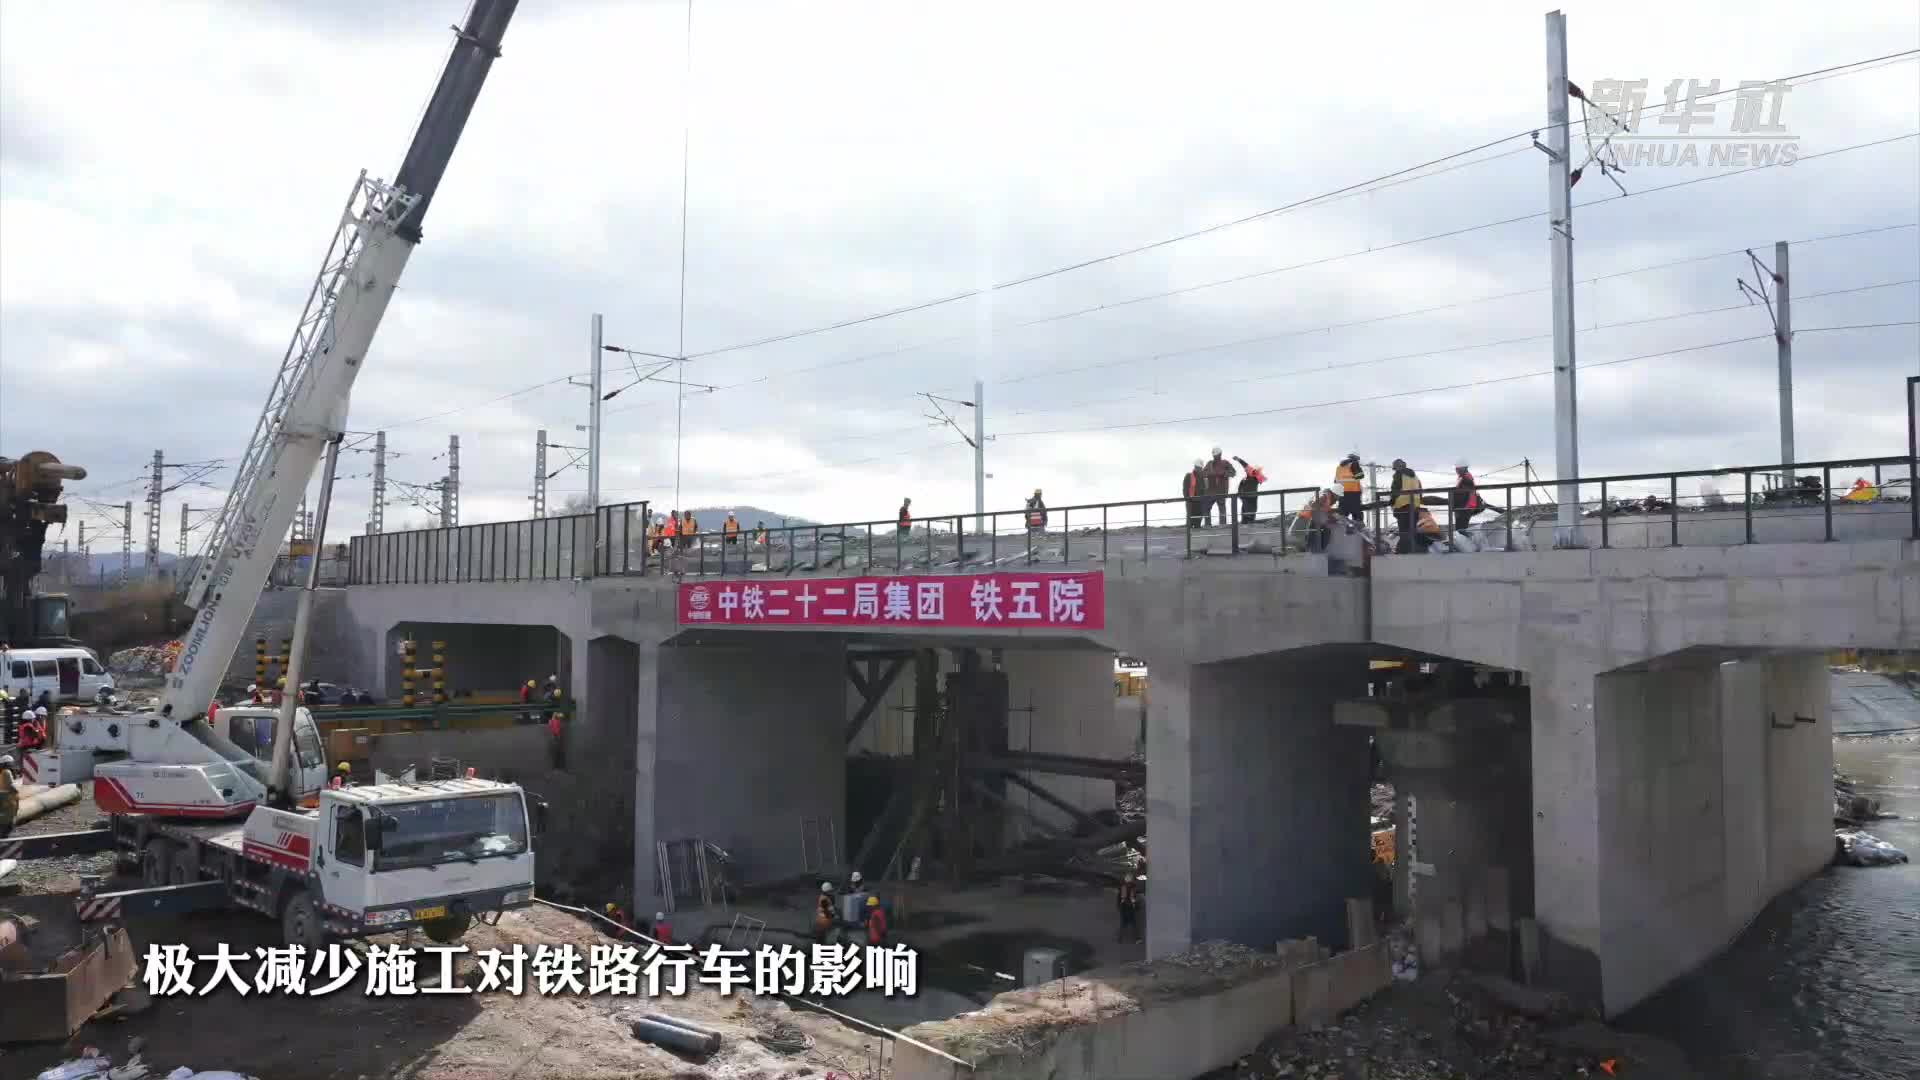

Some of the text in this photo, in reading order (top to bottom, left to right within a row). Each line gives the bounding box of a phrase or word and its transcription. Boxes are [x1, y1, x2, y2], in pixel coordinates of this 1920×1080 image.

[718, 578, 1085, 622] 中铁二十二局集团 铁五院
[181, 601, 219, 675] ZOOMLION
